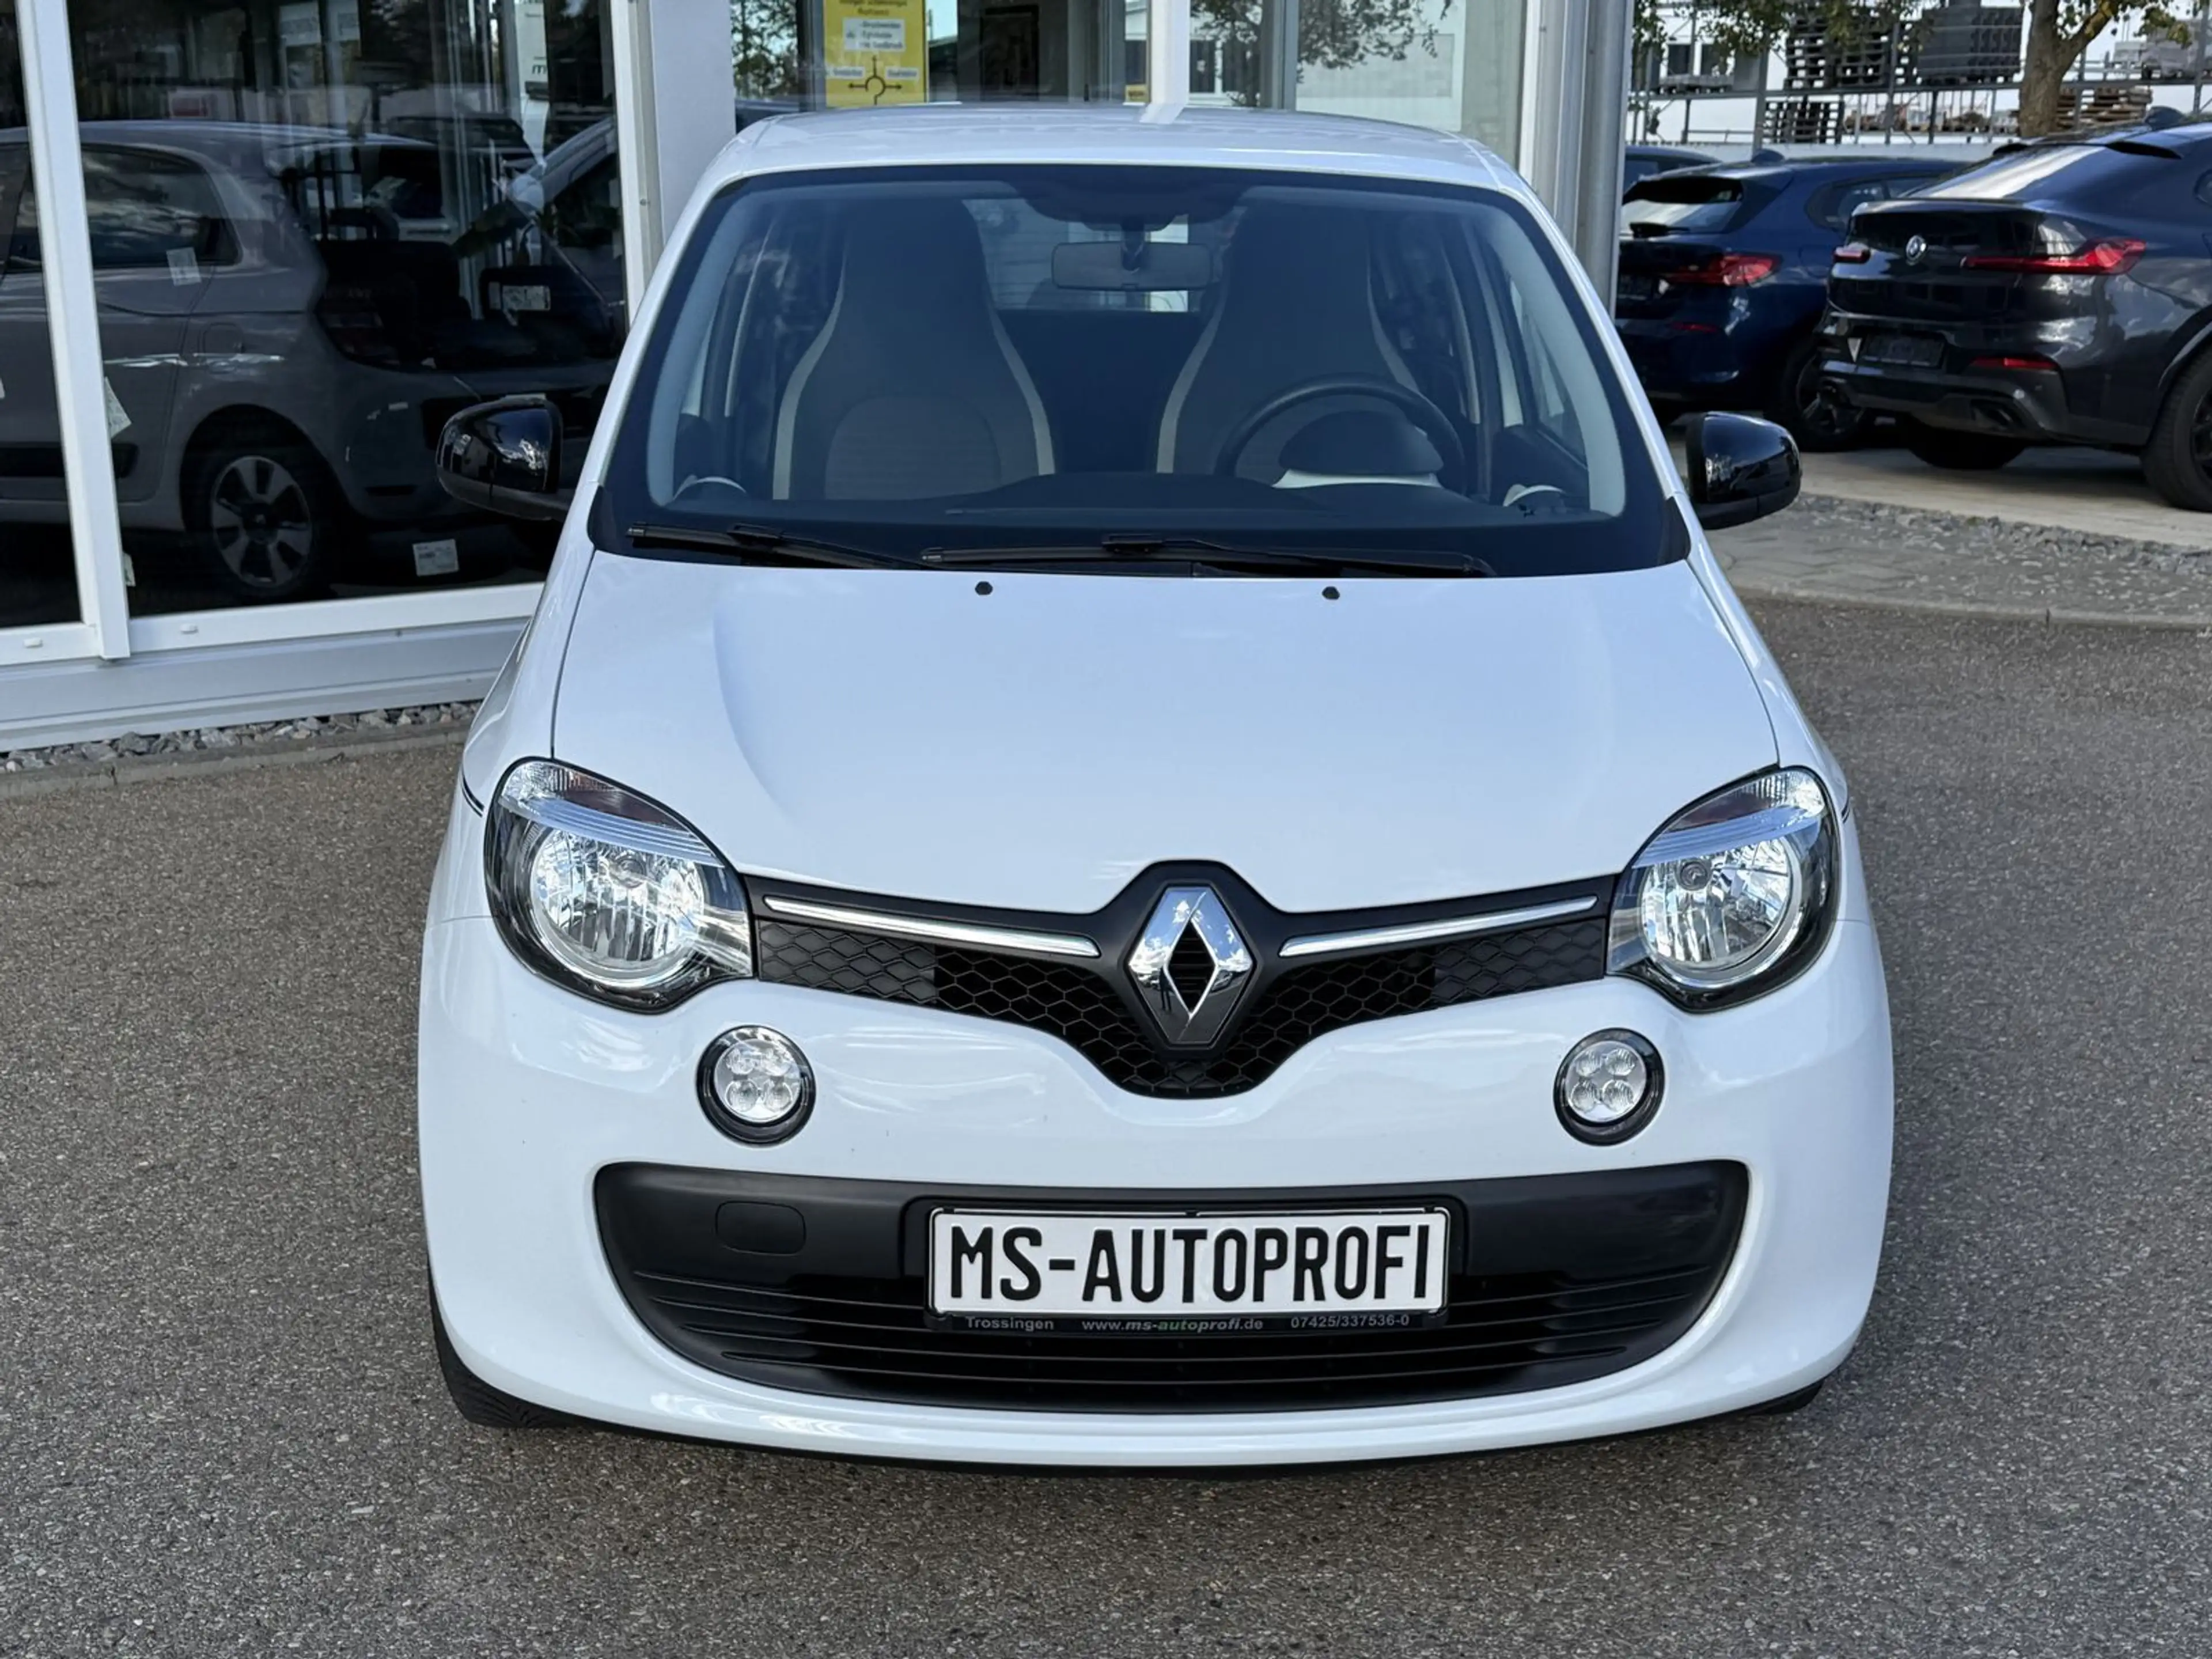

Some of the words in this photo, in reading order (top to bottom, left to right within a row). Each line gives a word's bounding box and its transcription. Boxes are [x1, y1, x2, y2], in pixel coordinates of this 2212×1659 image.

[950, 1225, 1430, 1303] MS-AUTOPROFI
[965, 1316, 1054, 1331] Trossingen
[1081, 1319, 1264, 1334] www.ms-autoprofi.de
[1290, 1314, 1410, 1329] 07425/337536-0
